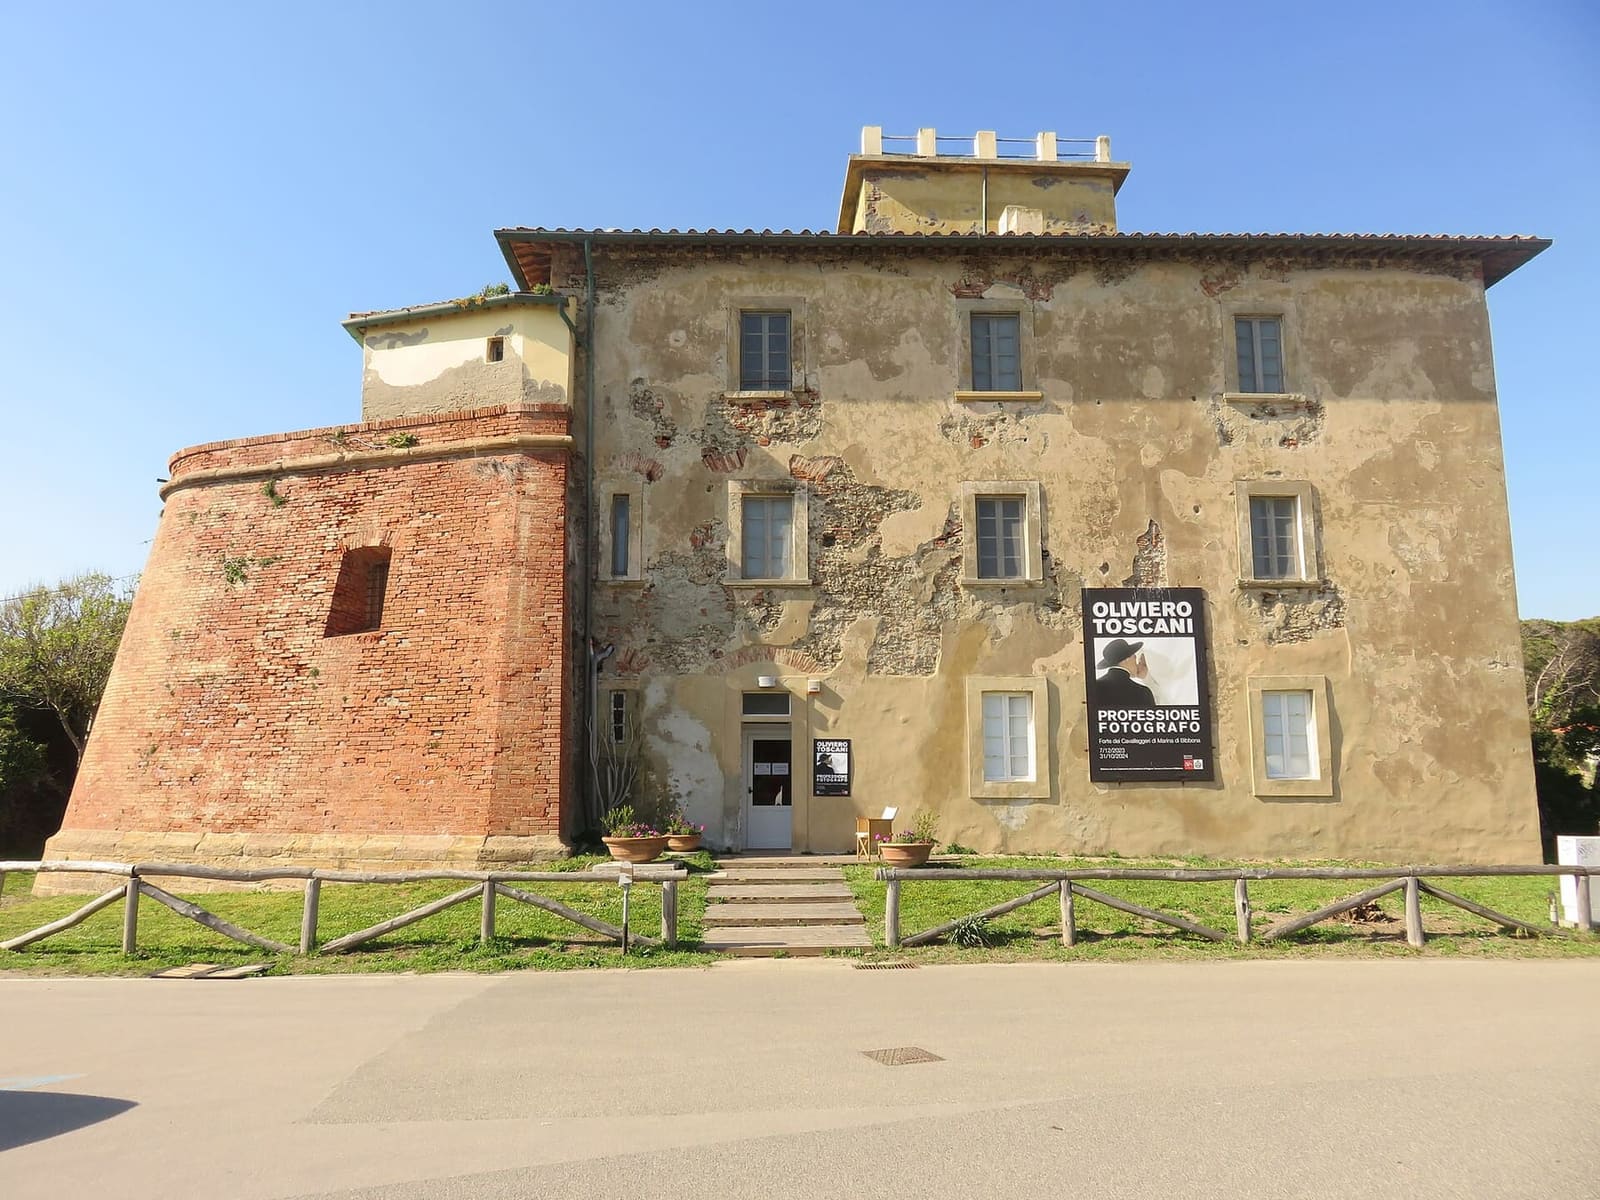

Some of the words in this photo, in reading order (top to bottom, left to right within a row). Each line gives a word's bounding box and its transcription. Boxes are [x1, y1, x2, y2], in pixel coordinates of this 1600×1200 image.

[1092, 601, 1193, 618] OLIVIERO
[1092, 618, 1194, 634] TOSCANI
[1098, 709, 1200, 721] PROFESSIONE
[1098, 721, 1200, 733] FOTOGRAFO
